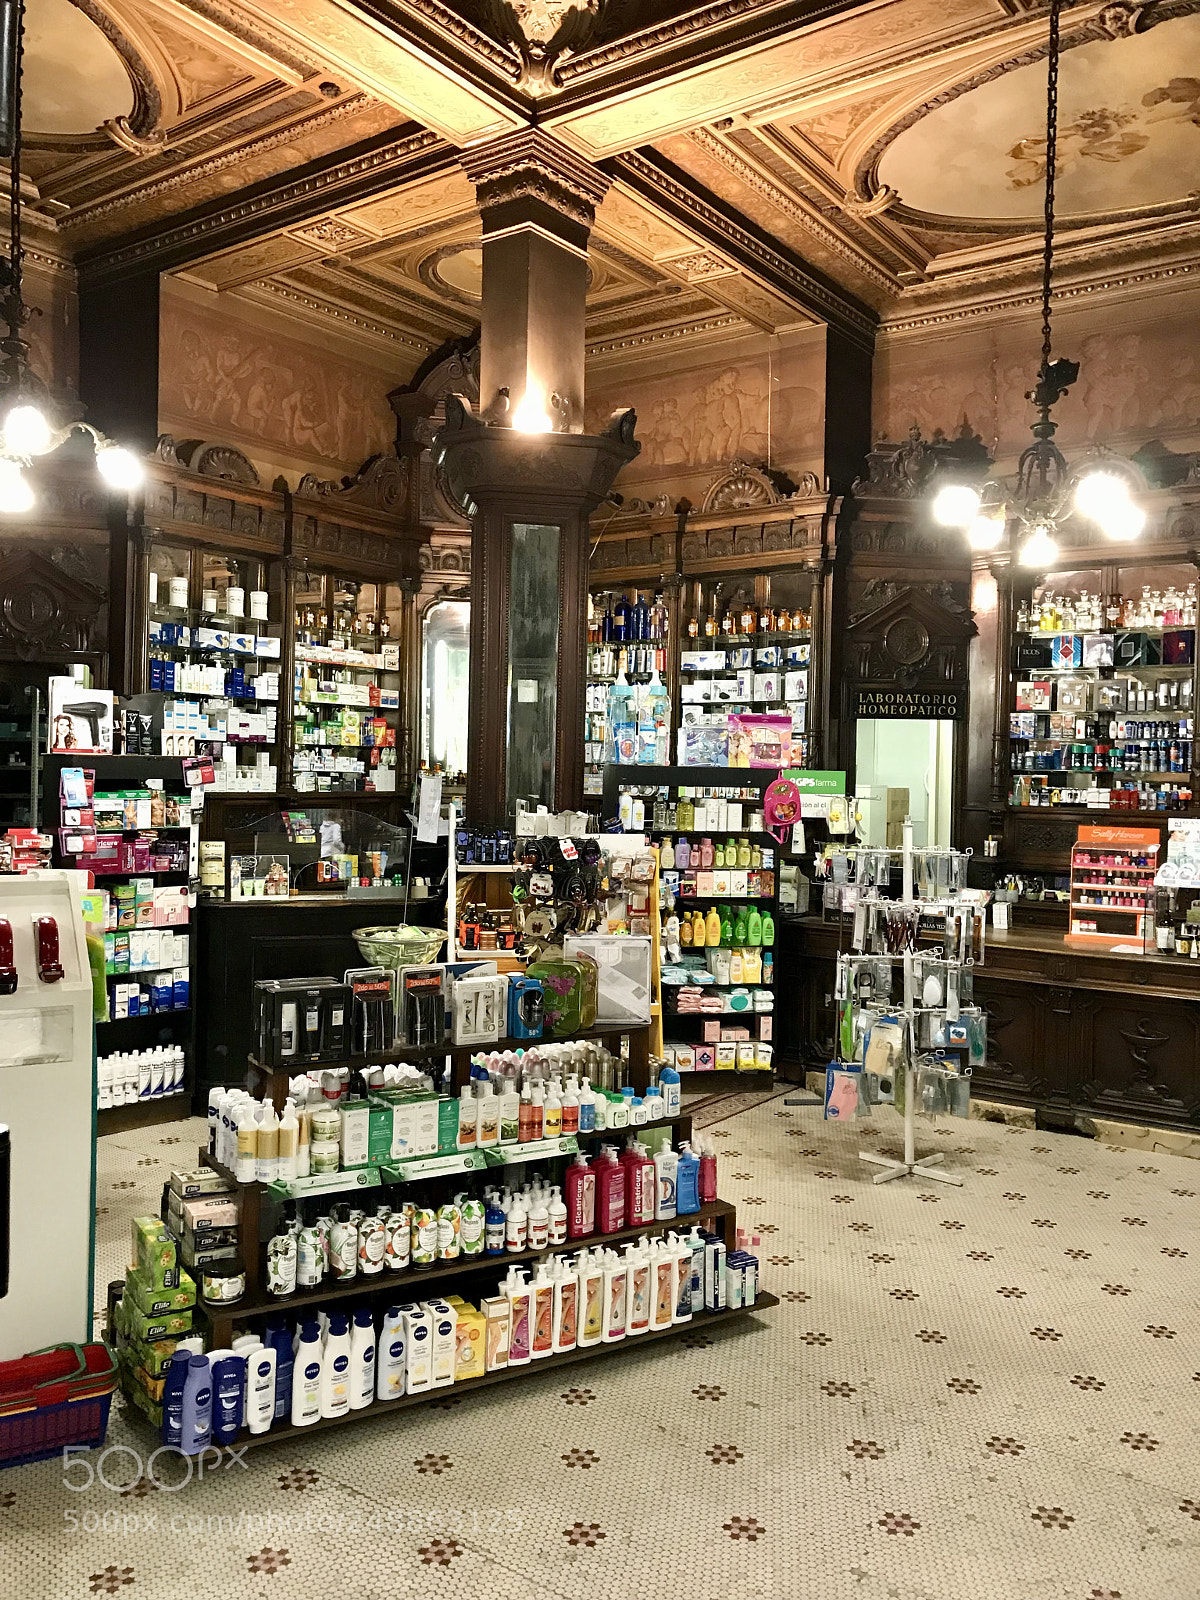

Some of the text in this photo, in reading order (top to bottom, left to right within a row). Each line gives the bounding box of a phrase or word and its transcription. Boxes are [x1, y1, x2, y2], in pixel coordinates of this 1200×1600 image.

[859, 693, 957, 705] LABORATORIO
[858, 704, 957, 716] HOMEOPATICO
[796, 778, 837, 787] GPS farma
[1091, 828, 1145, 841] Sally Hansen
[575, 1180, 583, 1224] Cicatricure
[153, 1301, 170, 1309] Elite
[149, 1326, 166, 1335] Elite
